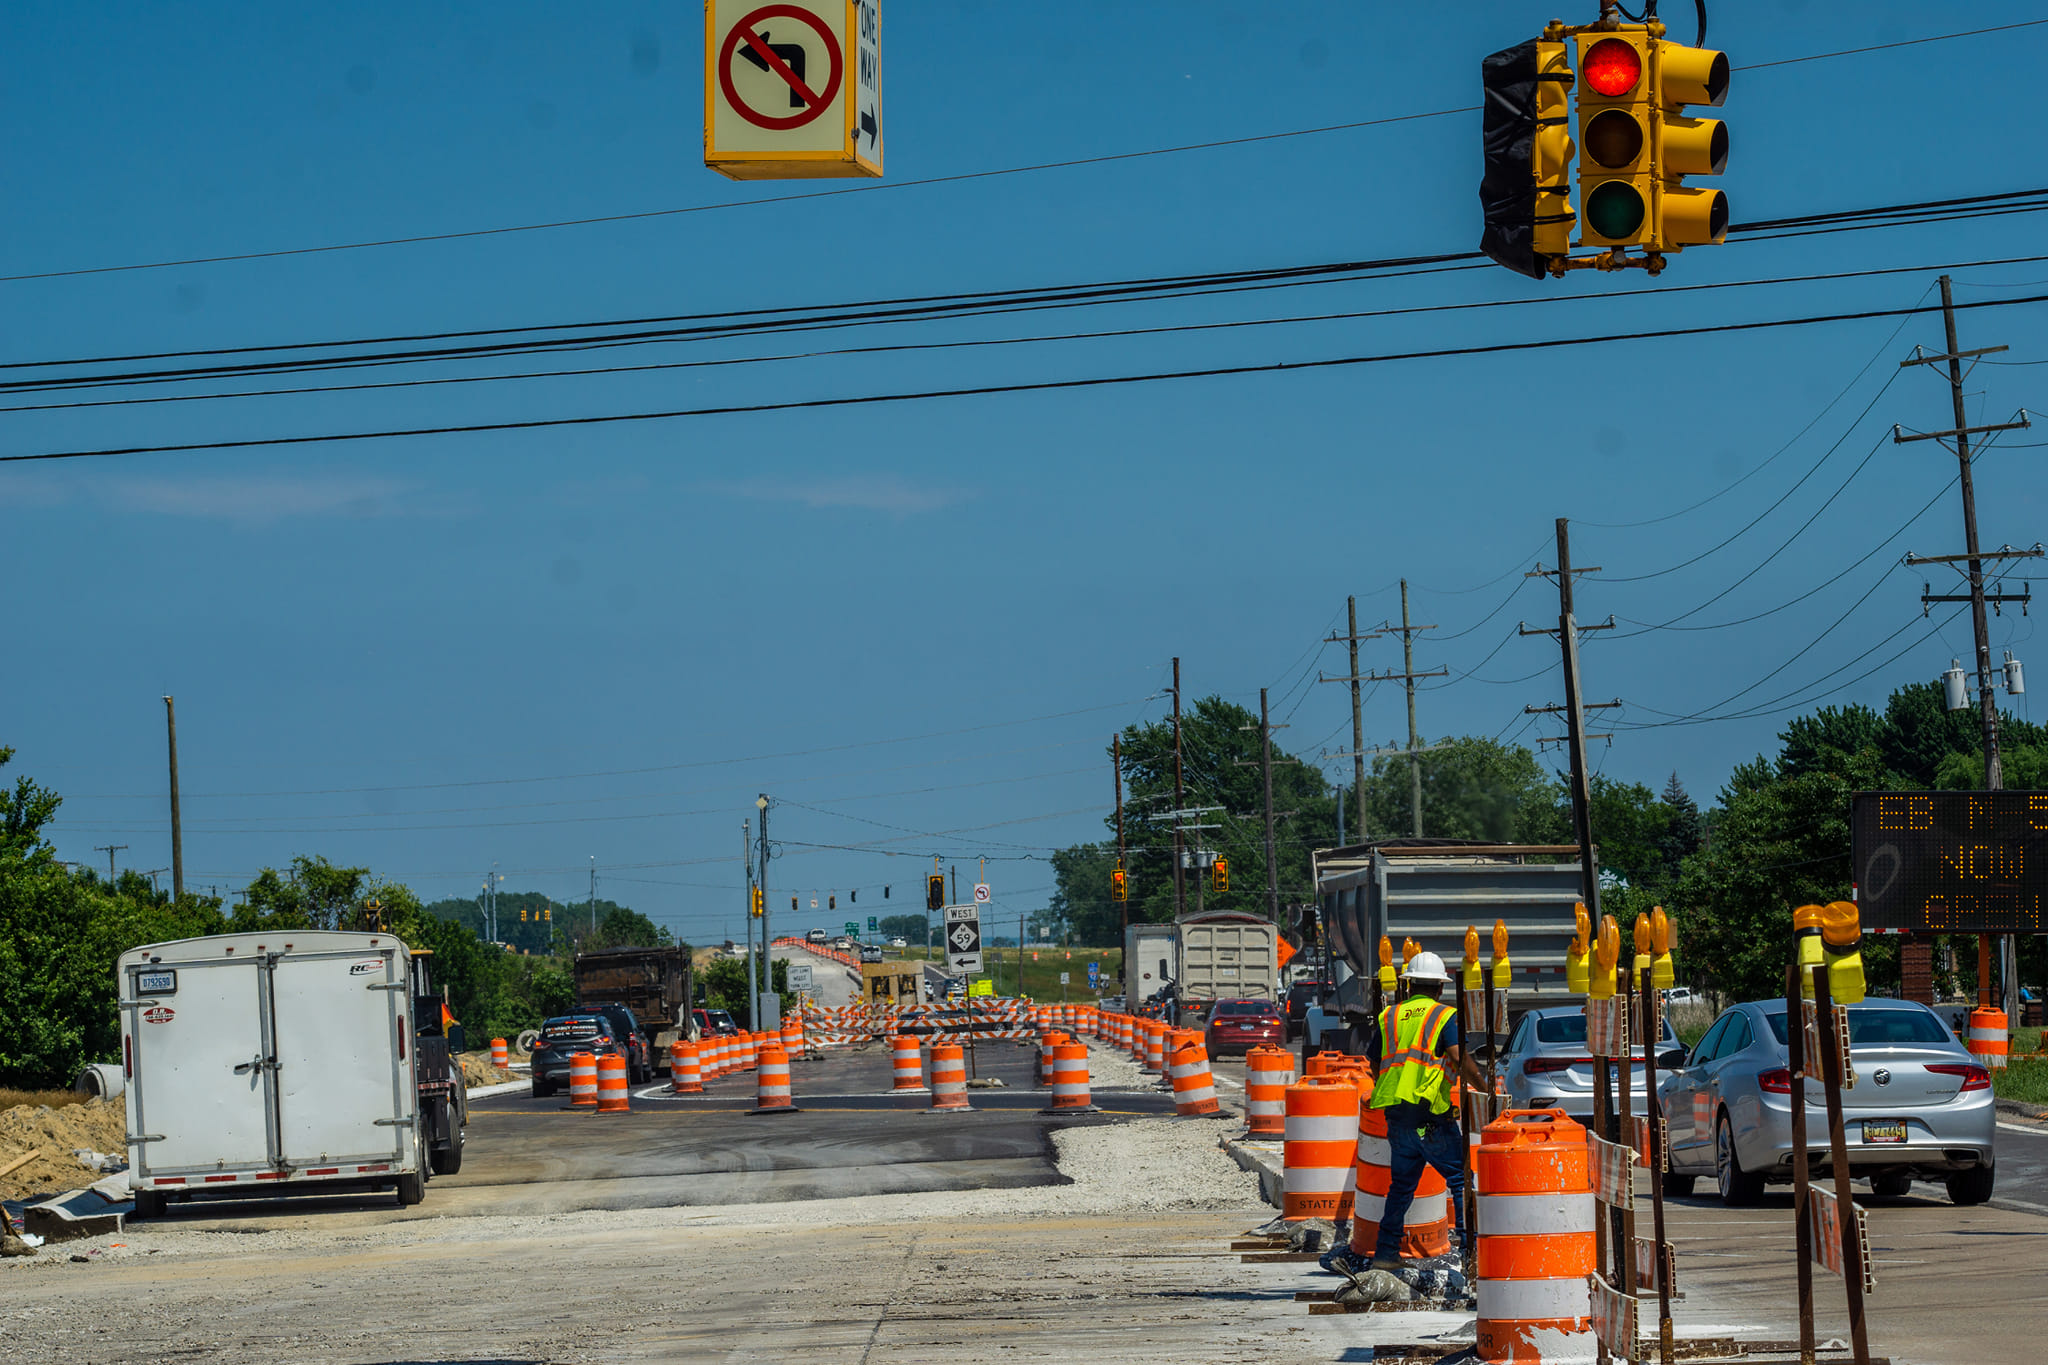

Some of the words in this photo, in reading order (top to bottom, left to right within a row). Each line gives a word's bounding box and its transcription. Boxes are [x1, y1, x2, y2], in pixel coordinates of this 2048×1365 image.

[861, 1, 876, 46] ONE
[861, 46, 877, 92] WAY
[1879, 796, 1934, 830] EB
[1940, 845, 2024, 879] NOW
[950, 909, 972, 919] WEST
[1925, 895, 2039, 928] OPEN
[956, 933, 971, 944] 59
[1299, 1199, 1335, 1209] STATE
[1341, 1199, 1355, 1209] BA
